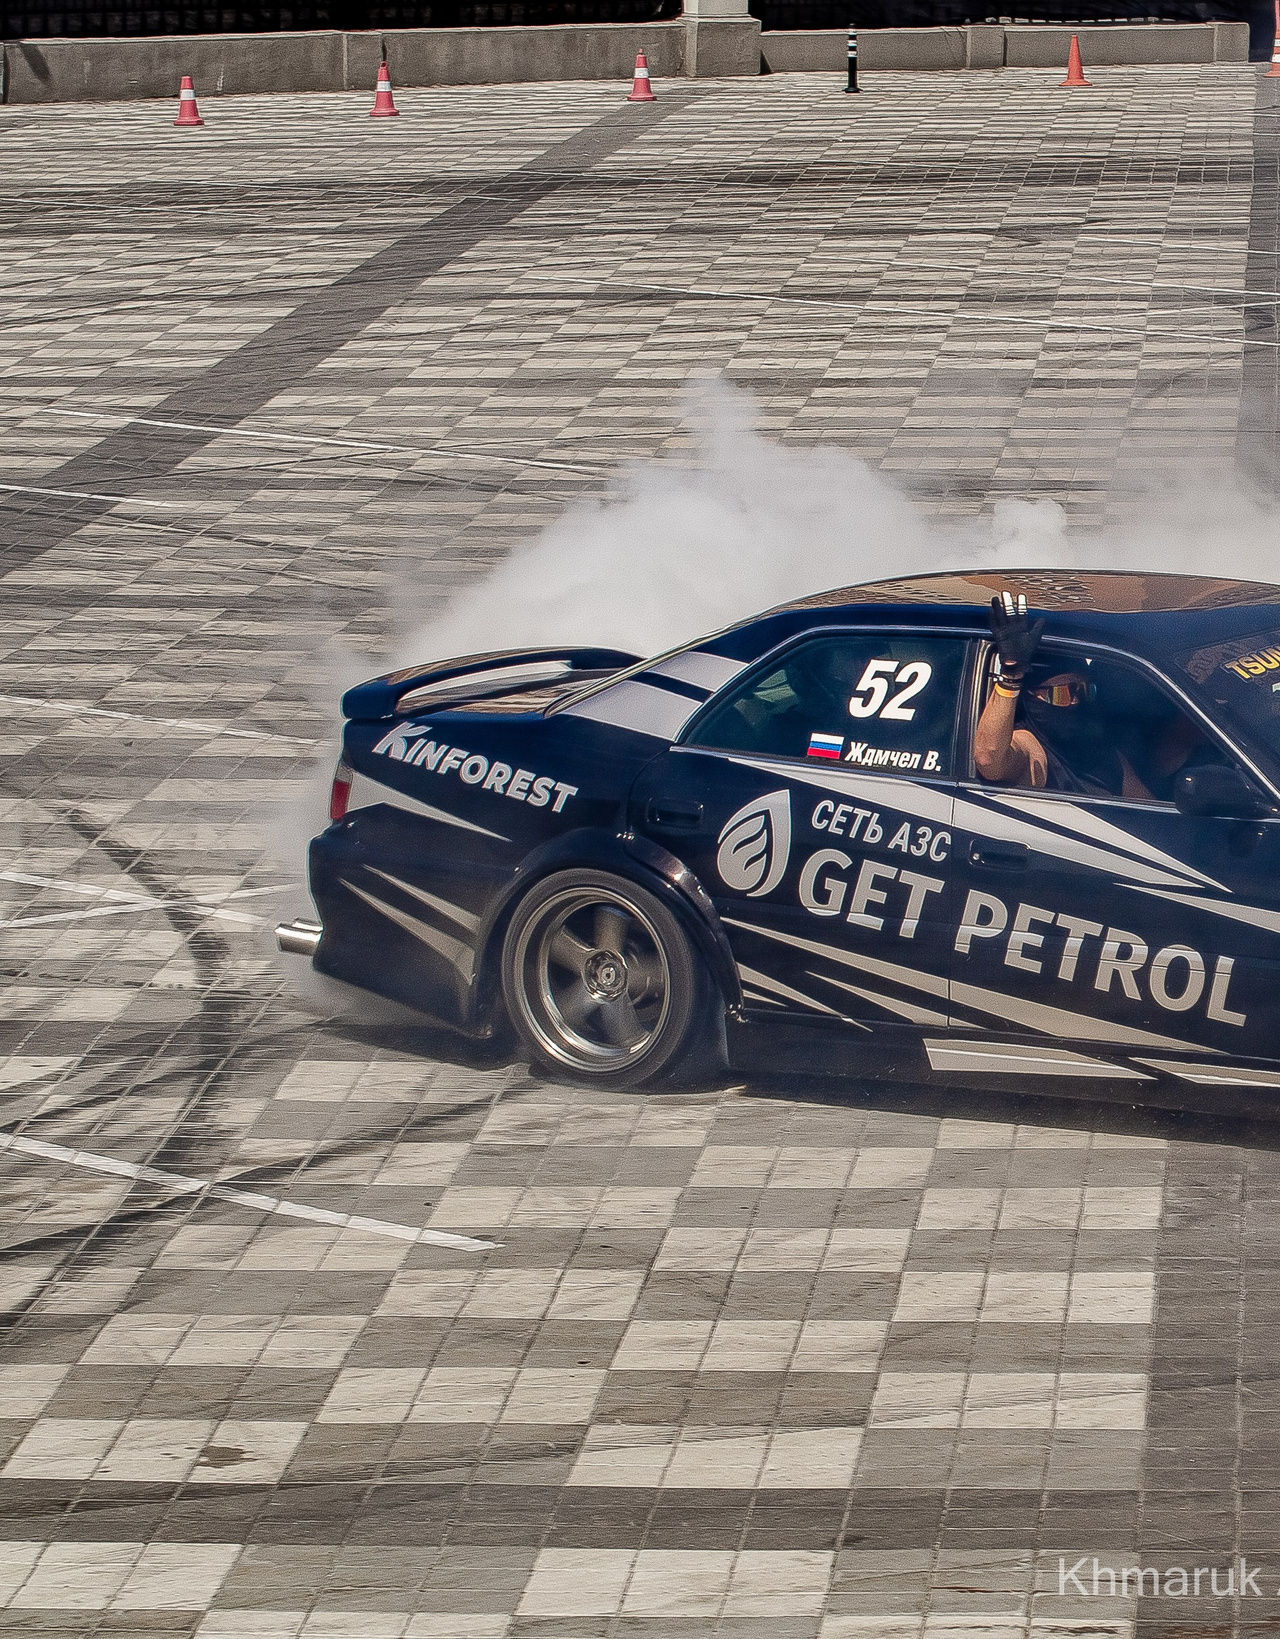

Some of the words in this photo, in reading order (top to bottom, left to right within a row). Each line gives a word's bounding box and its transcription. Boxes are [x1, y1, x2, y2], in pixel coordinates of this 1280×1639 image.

[849, 659, 932, 721] 52
[922, 750, 942, 772] В.
[811, 800, 885, 843] СЕТЬ
[887, 822, 953, 863] АЗС
[799, 849, 947, 938] GET
[954, 888, 1248, 1027] PETROL
